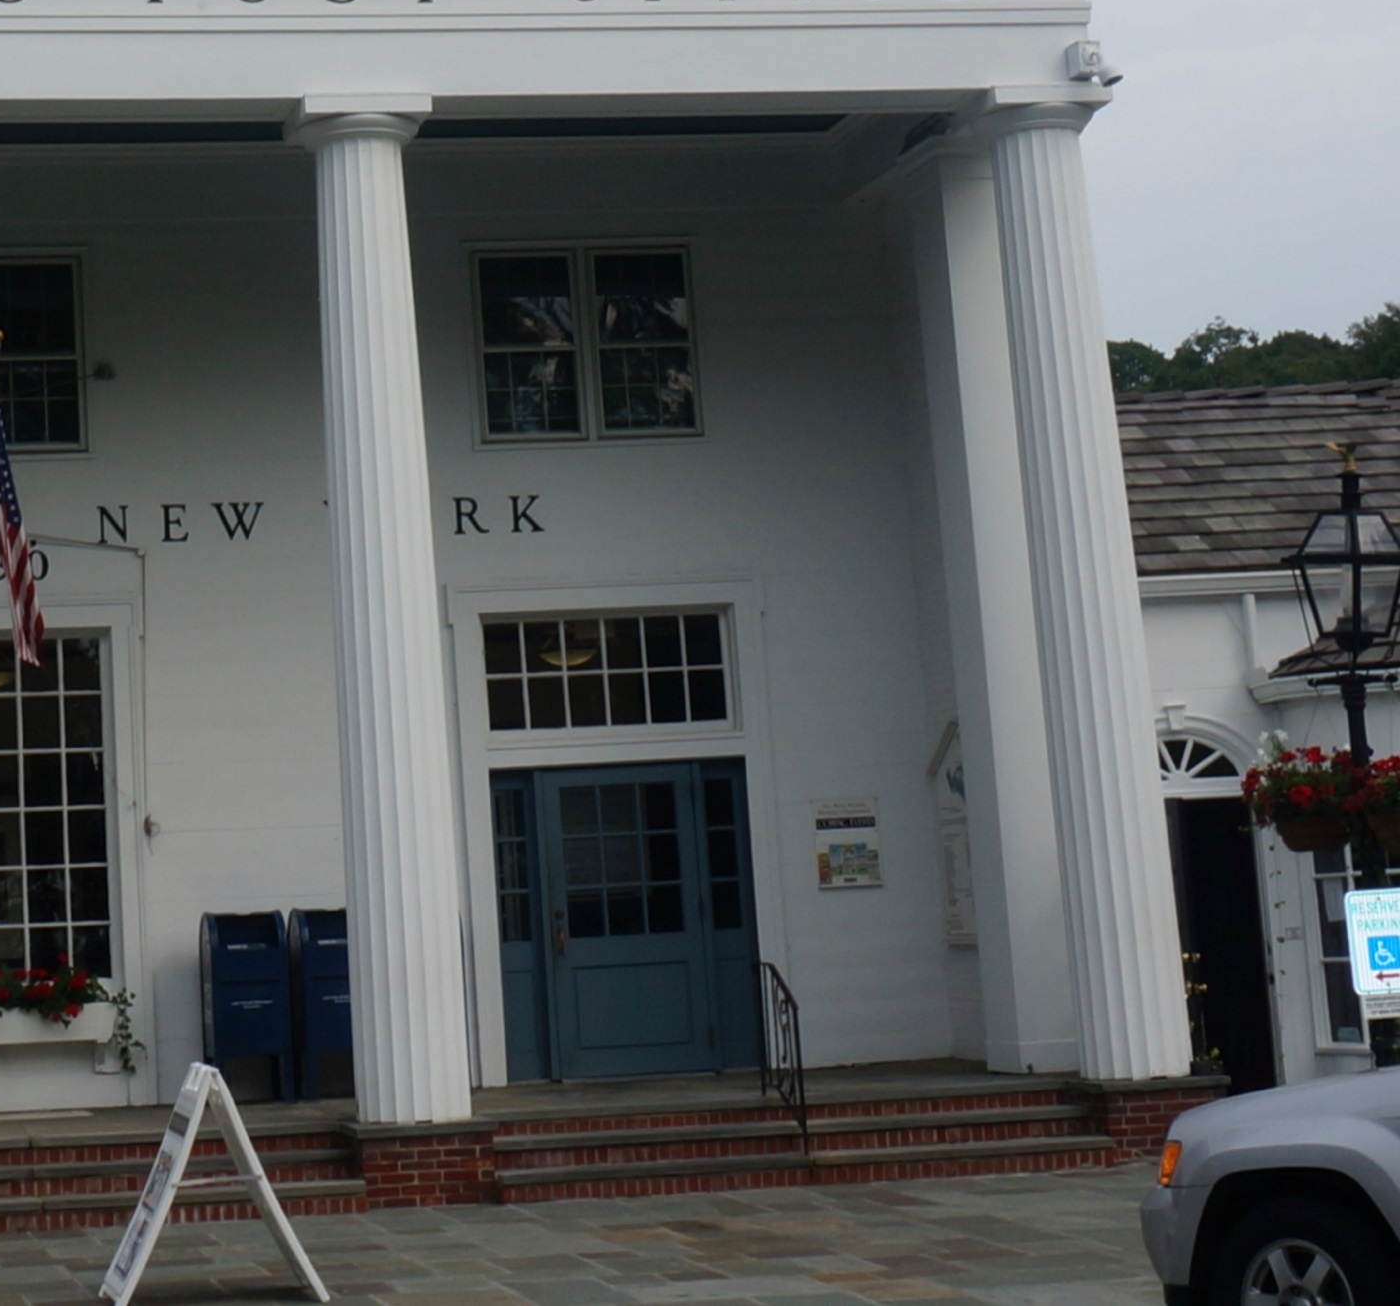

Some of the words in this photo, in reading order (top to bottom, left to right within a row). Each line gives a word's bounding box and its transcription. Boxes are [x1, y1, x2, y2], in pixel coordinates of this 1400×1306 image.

[96, 501, 264, 546] NEW
[1350, 900, 1400, 914] RESERVE
[1358, 919, 1400, 931] PARKIN
